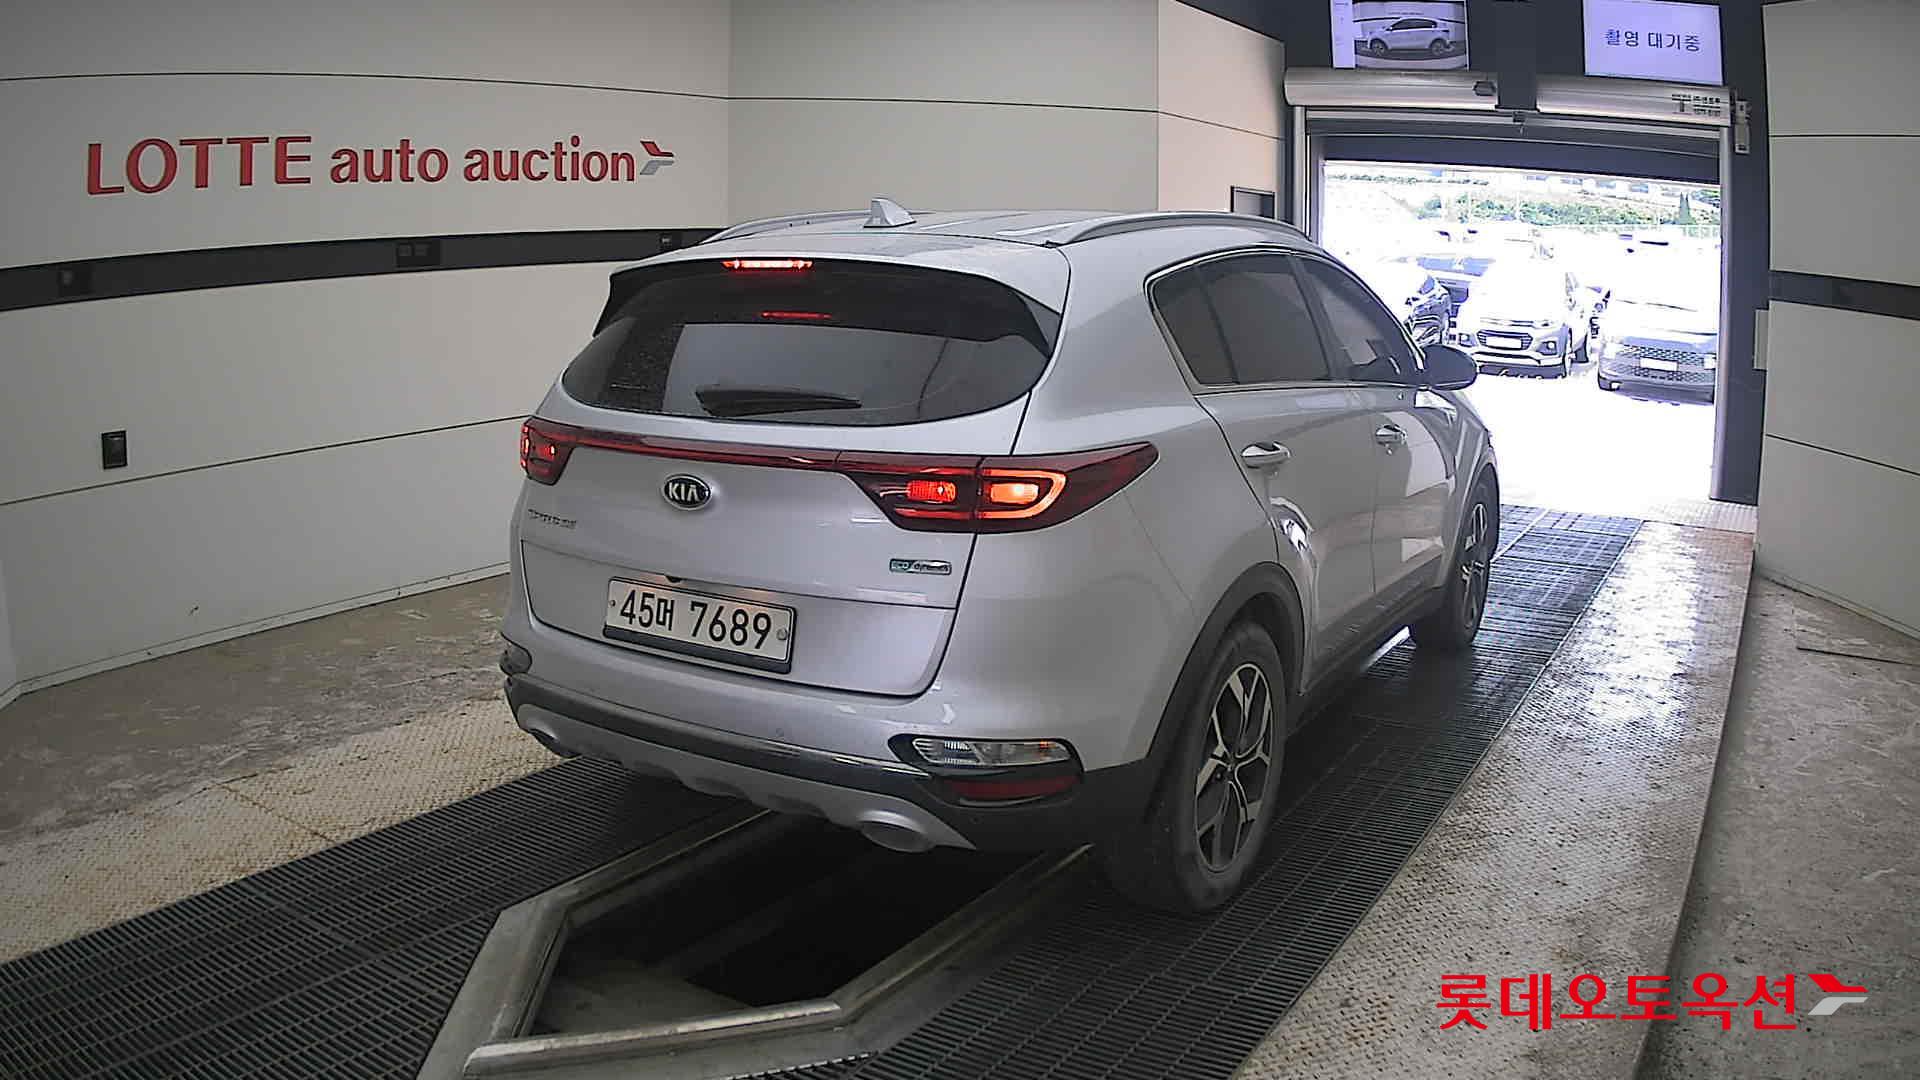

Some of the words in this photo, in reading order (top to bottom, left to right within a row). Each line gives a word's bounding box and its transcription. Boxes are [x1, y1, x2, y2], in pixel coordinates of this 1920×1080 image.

[1648, 32, 1700, 52] 대기중
[87, 136, 311, 195] LOTTE
[330, 138, 448, 183] auto
[463, 135, 634, 182] auction
[668, 481, 699, 501] KIA
[620, 589, 674, 631] 45머
[690, 603, 772, 650] 7689
